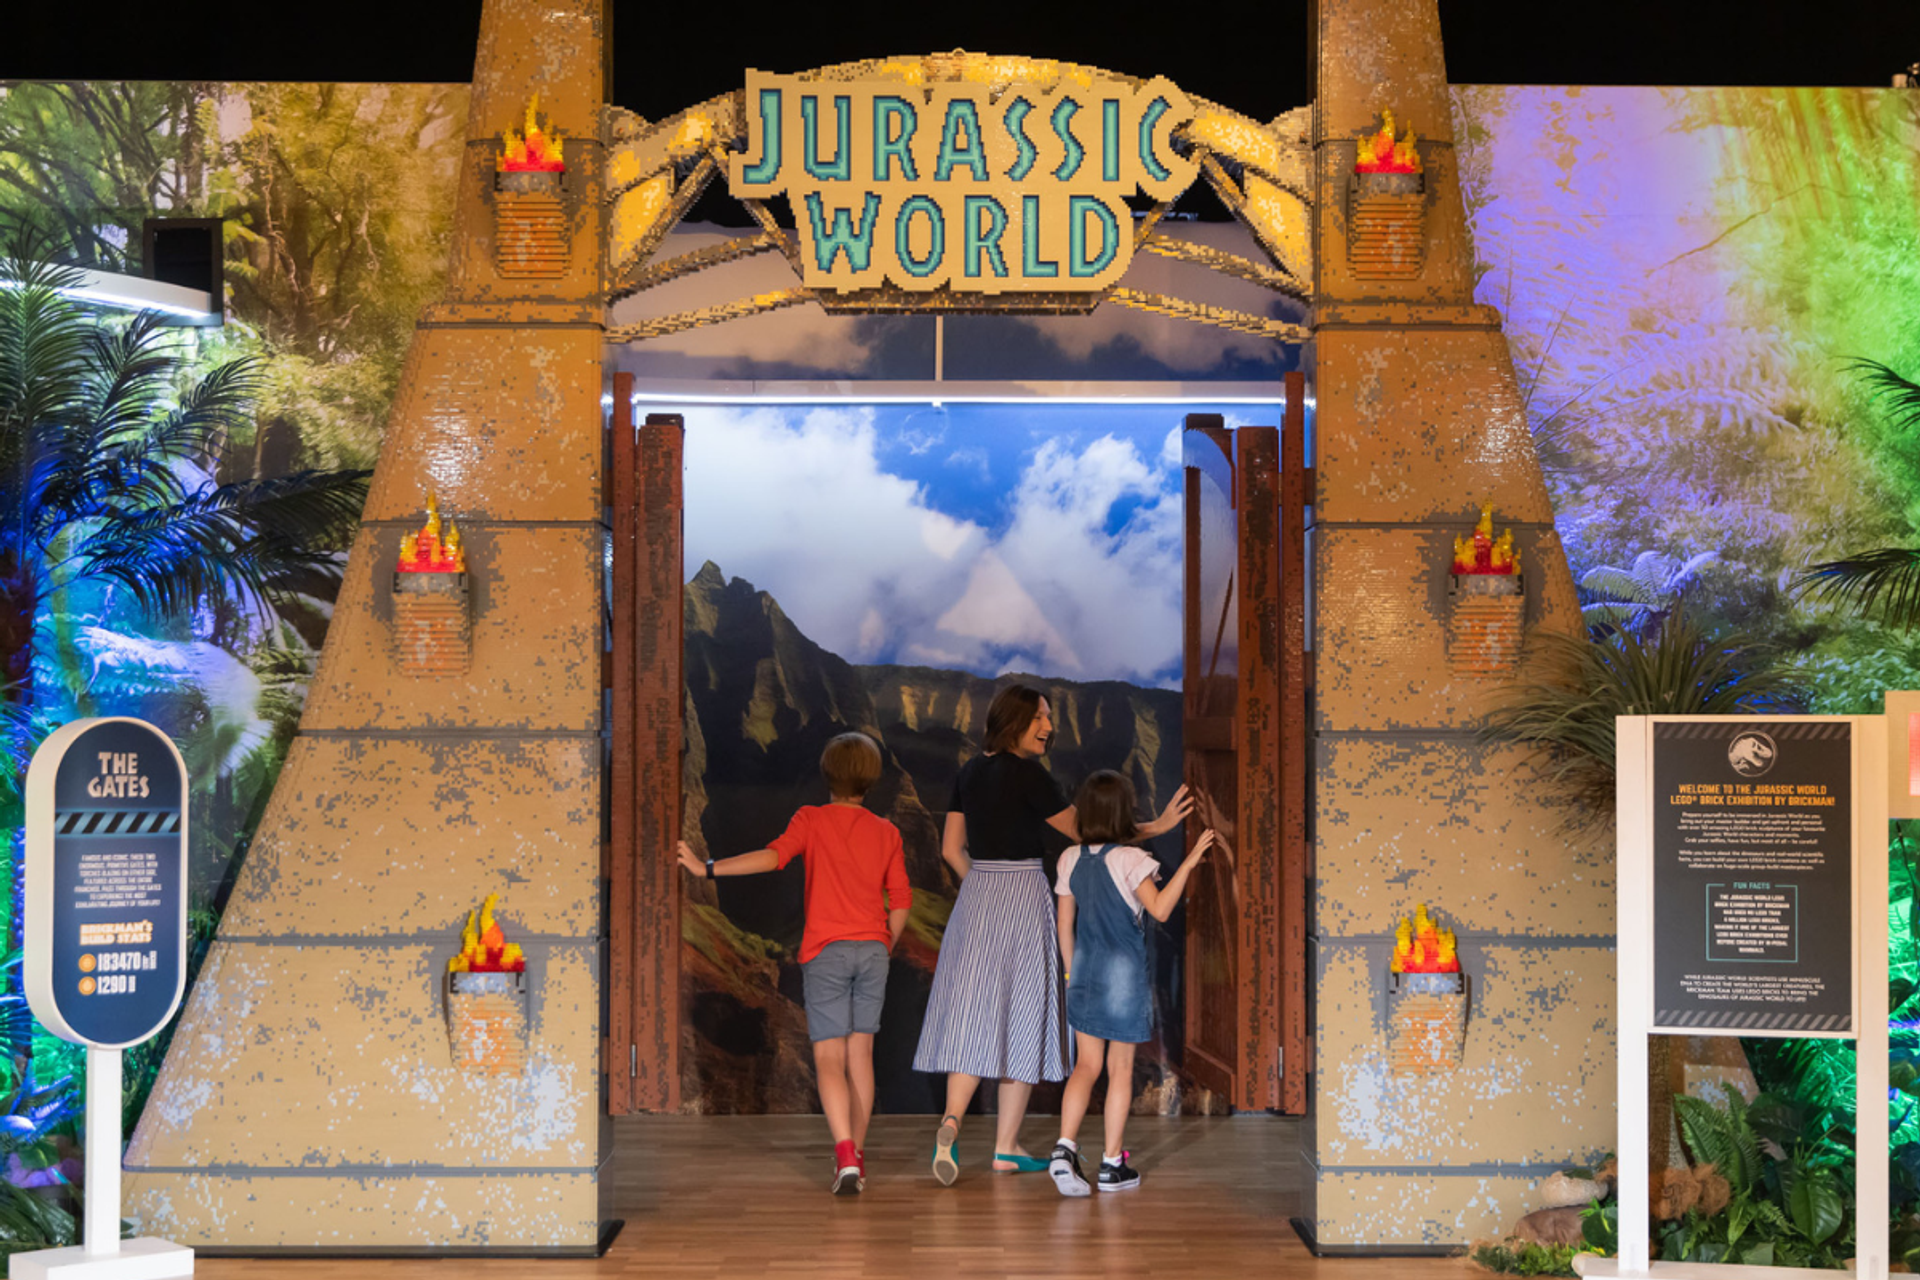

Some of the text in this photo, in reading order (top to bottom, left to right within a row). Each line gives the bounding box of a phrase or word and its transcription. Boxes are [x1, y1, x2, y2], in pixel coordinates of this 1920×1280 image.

[743, 88, 1172, 184] JURASSIC
[804, 191, 1119, 277] WORLD
[98, 752, 138, 775] THE
[87, 775, 150, 798] GATES
[1678, 784, 1827, 795] WELCOME TO THE JURASSIC WORLD
[1700, 795, 1724, 805] BRICK
[1727, 795, 1772, 806] EXHIBITION
[1774, 796, 1786, 806] BY
[1788, 796, 1835, 807] BRICKMAN!
[117, 932, 152, 944] STATS
[98, 952, 141, 972] 183470
[97, 975, 127, 994] 1290
